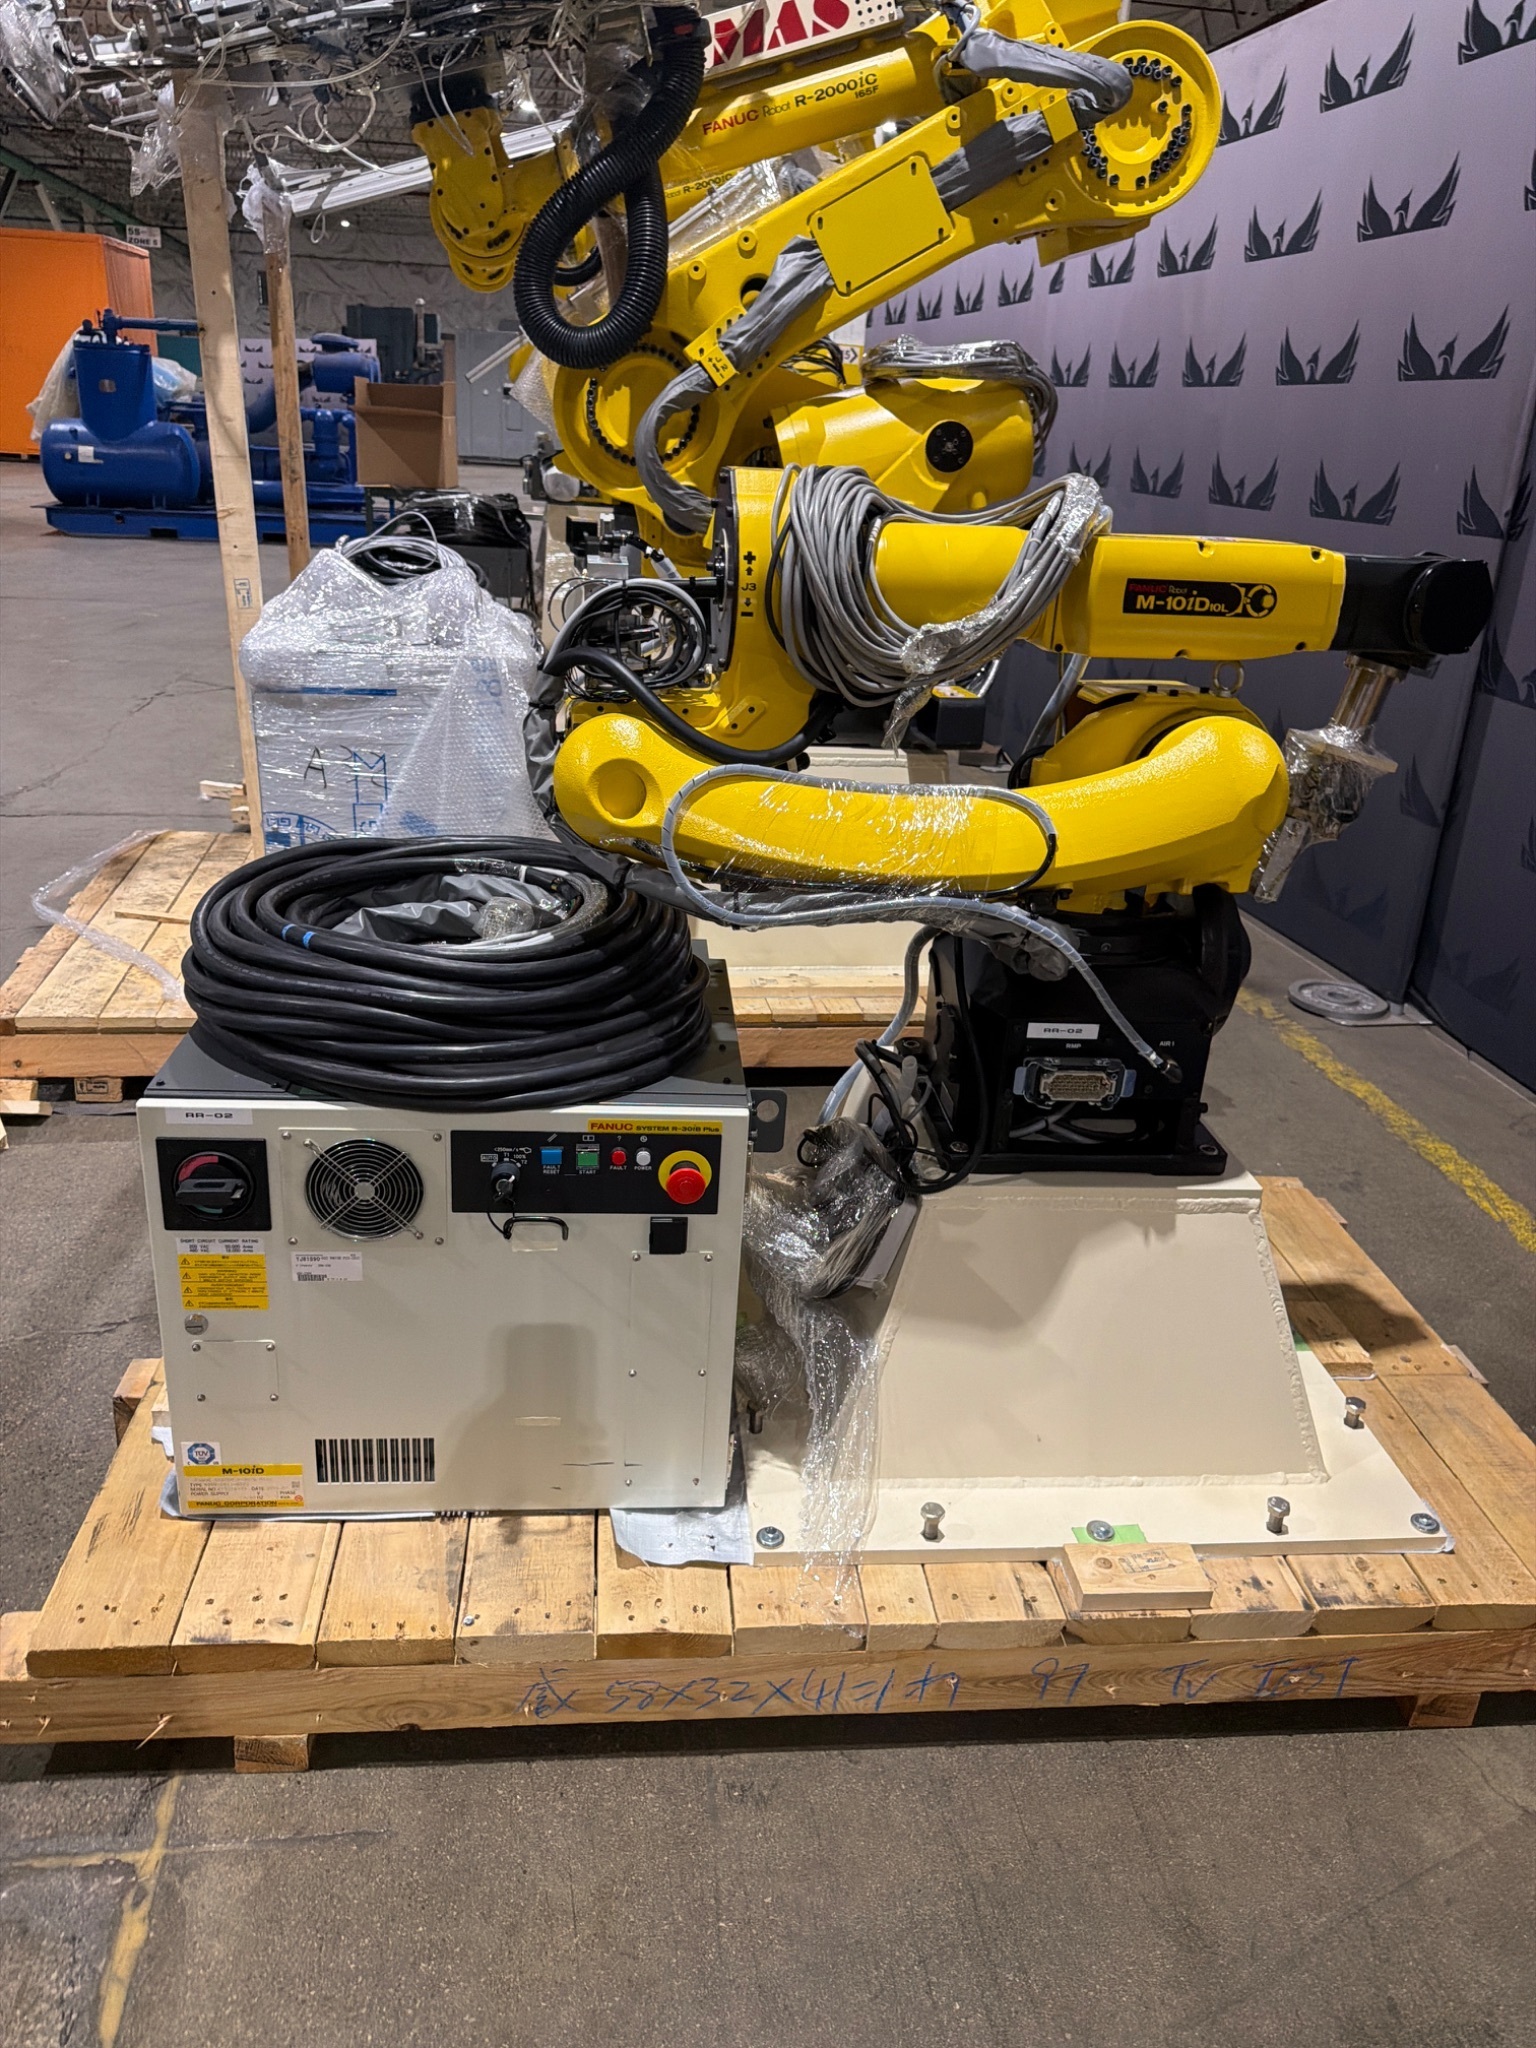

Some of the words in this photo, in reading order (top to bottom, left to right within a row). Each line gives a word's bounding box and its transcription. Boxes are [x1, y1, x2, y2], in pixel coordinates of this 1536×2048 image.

[855, 85, 880, 99] 165F
[703, 109, 760, 136] FANUC
[762, 101, 792, 118] Robot
[794, 71, 878, 108] R-2000iC
[741, 582, 757, 592] J3
[1128, 583, 1168, 593] FANUC
[1168, 585, 1188, 594] Robot
[590, 1123, 633, 1131] FANUC
[222, 1465, 265, 1475] M-10iD
